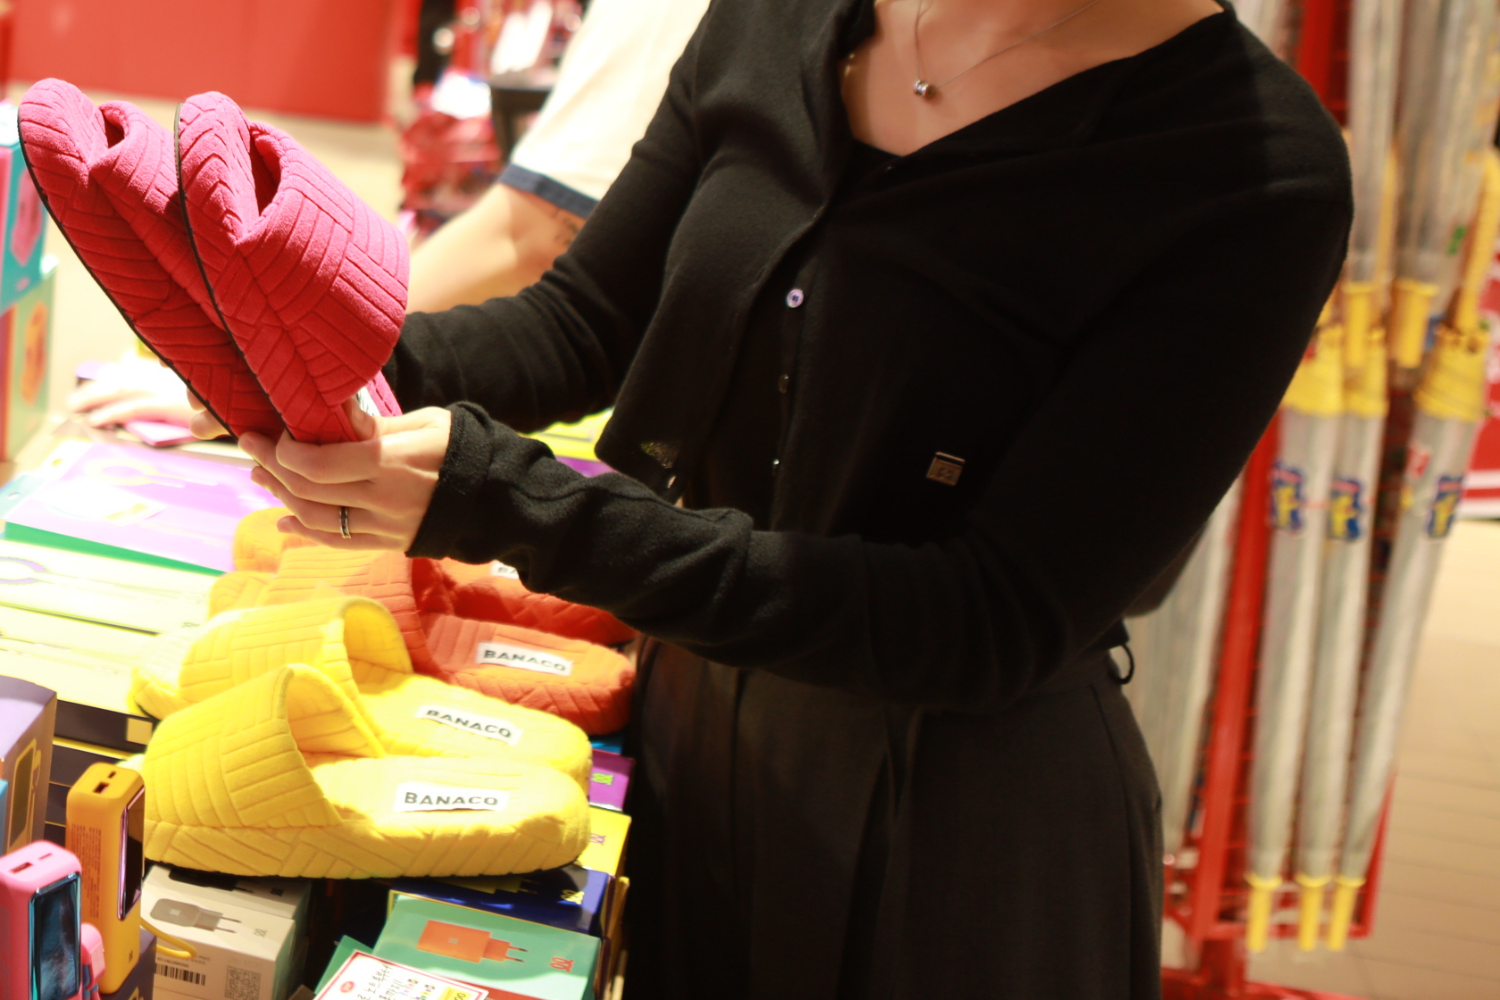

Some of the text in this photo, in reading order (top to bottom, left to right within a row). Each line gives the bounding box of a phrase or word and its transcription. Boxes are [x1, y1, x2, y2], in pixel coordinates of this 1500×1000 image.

[483, 648, 567, 673] BANACO
[425, 709, 512, 739] BANACO
[403, 791, 499, 806] BANACO
